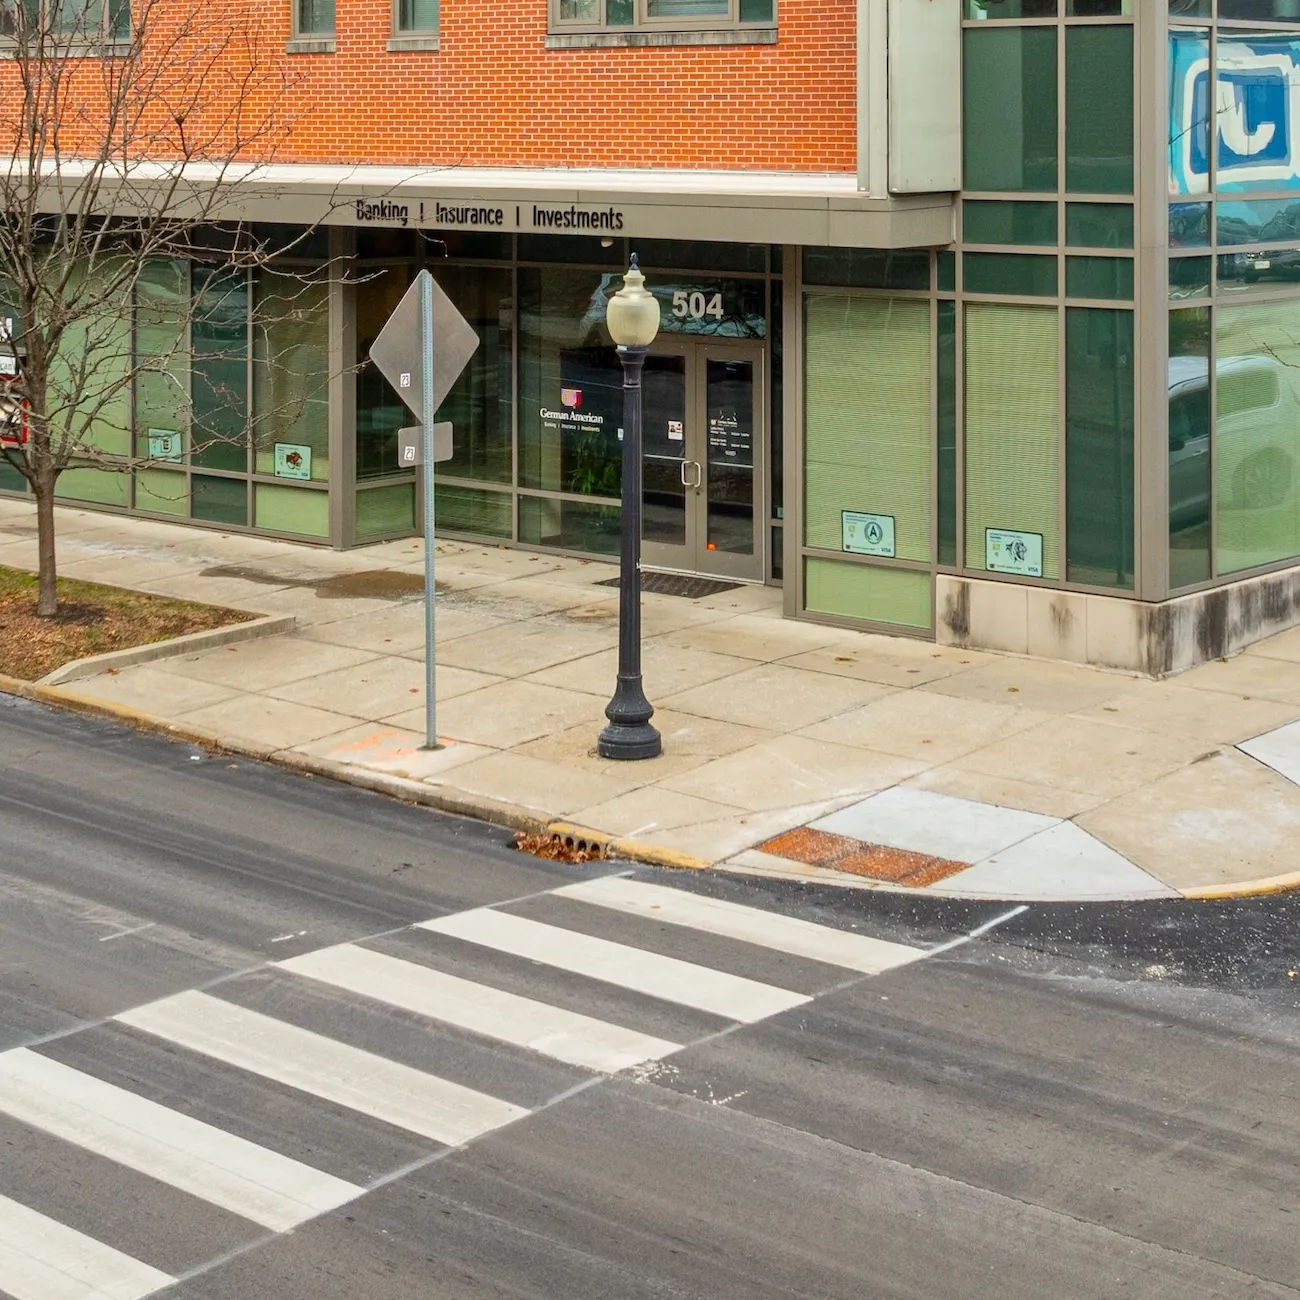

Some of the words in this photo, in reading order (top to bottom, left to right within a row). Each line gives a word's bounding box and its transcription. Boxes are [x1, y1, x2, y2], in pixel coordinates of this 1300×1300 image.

[356, 199, 409, 226] Banking
[435, 202, 503, 226] Insurance
[532, 205, 624, 230] Investments
[671, 291, 725, 320] 504
[539, 407, 569, 420] German
[569, 411, 604, 424] American
